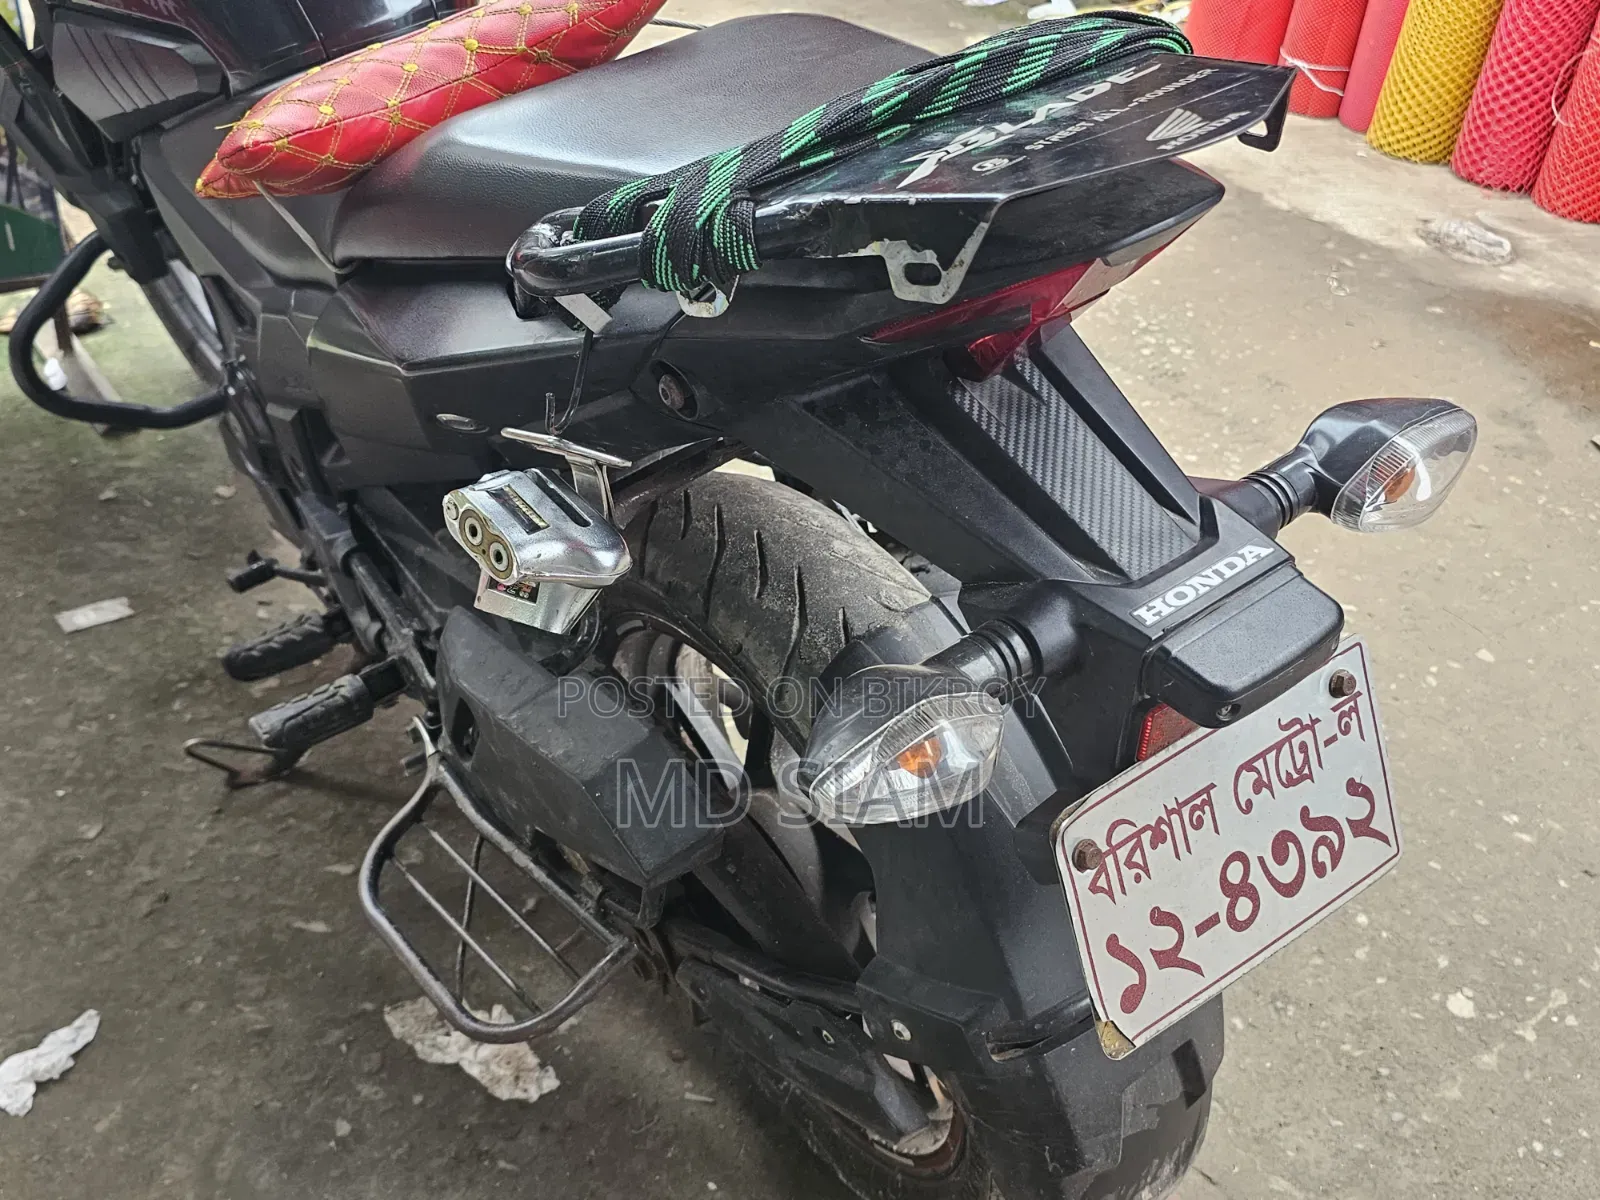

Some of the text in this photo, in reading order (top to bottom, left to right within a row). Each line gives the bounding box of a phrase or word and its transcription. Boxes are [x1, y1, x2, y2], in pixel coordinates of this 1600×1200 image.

[1024, 68, 1220, 150] STREET ALL-ROUNDER
[1156, 110, 1251, 150] HONDA
[1133, 544, 1275, 626] HONDA
[1088, 690, 1365, 906] বরিশাল মেট্রো-ল
[1105, 777, 1392, 1014] ১২-৪৩৯২
